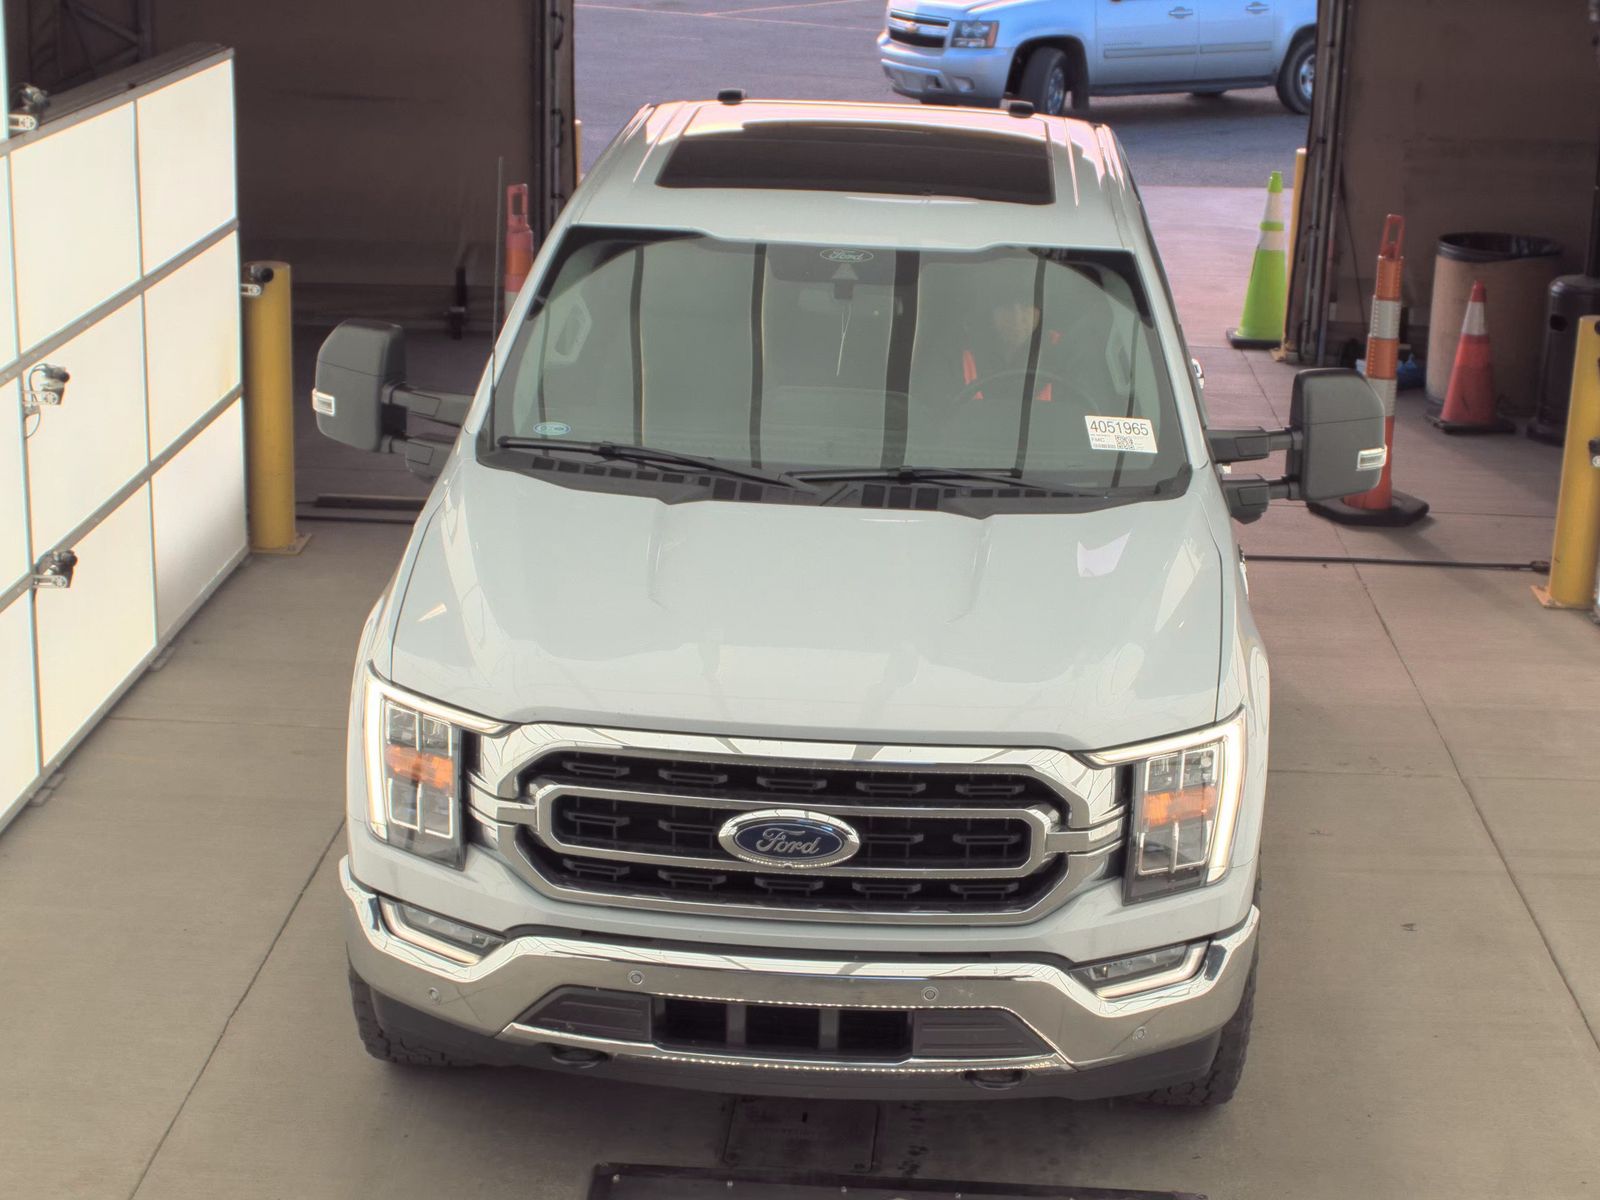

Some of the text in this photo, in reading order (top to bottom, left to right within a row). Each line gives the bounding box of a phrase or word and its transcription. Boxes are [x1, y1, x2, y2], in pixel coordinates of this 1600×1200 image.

[828, 248, 865, 262] Ford
[1090, 420, 1149, 436] 4051965
[756, 827, 821, 854] Ford
